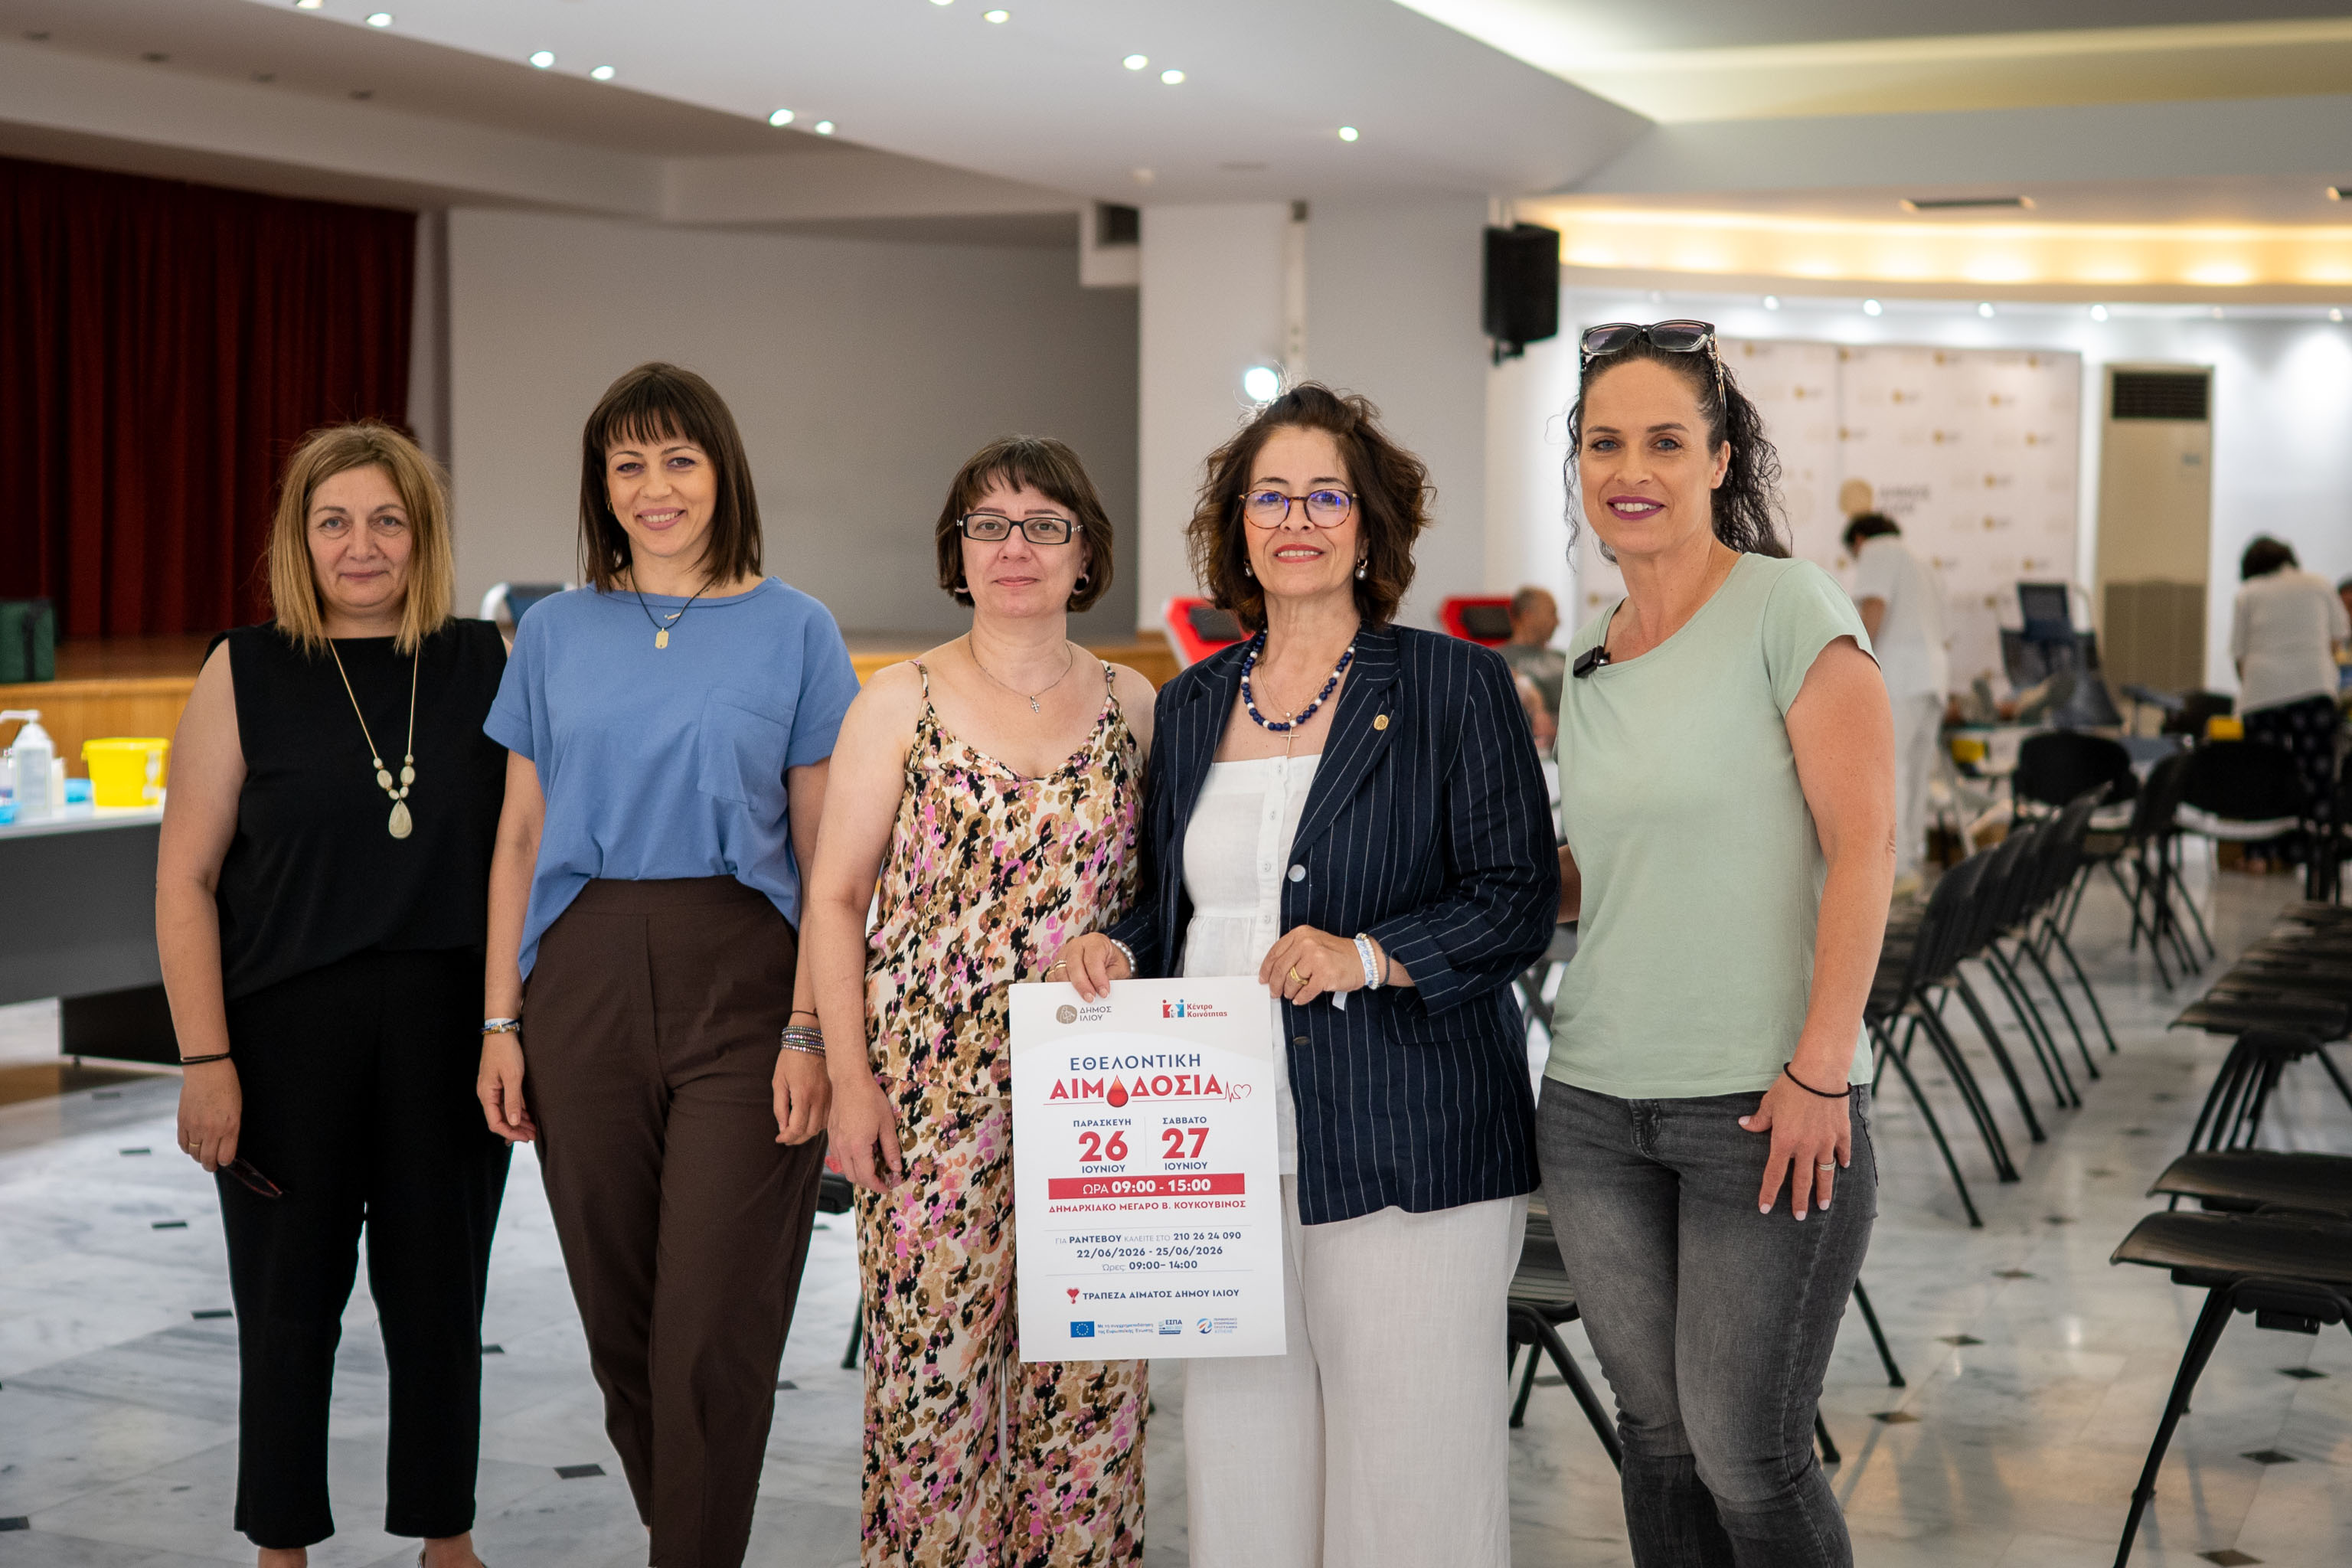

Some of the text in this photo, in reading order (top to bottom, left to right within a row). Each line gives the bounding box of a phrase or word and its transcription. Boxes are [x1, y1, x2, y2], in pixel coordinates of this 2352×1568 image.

[1080, 1005, 1112, 1014] ΔΗΜΟΣ
[1070, 1053, 1200, 1071] ΕΘΕΛΟΝΤΙΚΗ
[1073, 1118, 1132, 1128] ΠΑΡΑΣΚΕΥΗ
[1162, 1116, 1207, 1125] ΣΑΒΒΑΤΟ
[1078, 1130, 1129, 1162] 26
[1161, 1127, 1210, 1159] 27
[1082, 1164, 1126, 1174] ΙΟΥΝΙΟΥ
[1165, 1161, 1208, 1171] ΙΟΥΝΙΟΥ
[1083, 1184, 1109, 1195] ΩΡΑ
[1111, 1179, 1156, 1194] 09:00
[1168, 1178, 1211, 1192] 15:00
[1048, 1200, 1246, 1214] ΔΗΜΑΡΧΙΑΚΟ ΜΕΓΑΡΟ Β. ΚΟΥΚΟΥΒΙΝΟΣ
[1069, 1234, 1122, 1244] ΡΑΝΤΕΒΟΥ
[1173, 1232, 1191, 1241] 210
[1193, 1232, 1205, 1240] 26
[1207, 1232, 1220, 1240] 24
[1222, 1231, 1242, 1240] 090
[1076, 1246, 1146, 1259] 22/06/2026
[1155, 1245, 1223, 1257] 25/06/2026
[1168, 1259, 1198, 1269] 14:00
[1082, 1292, 1127, 1300] ΤΡΑΠΕΖΑ
[1129, 1290, 1173, 1299] ΑΙΜΑΤΟΣ
[1174, 1289, 1210, 1298] ΔΗΜΟΥ
